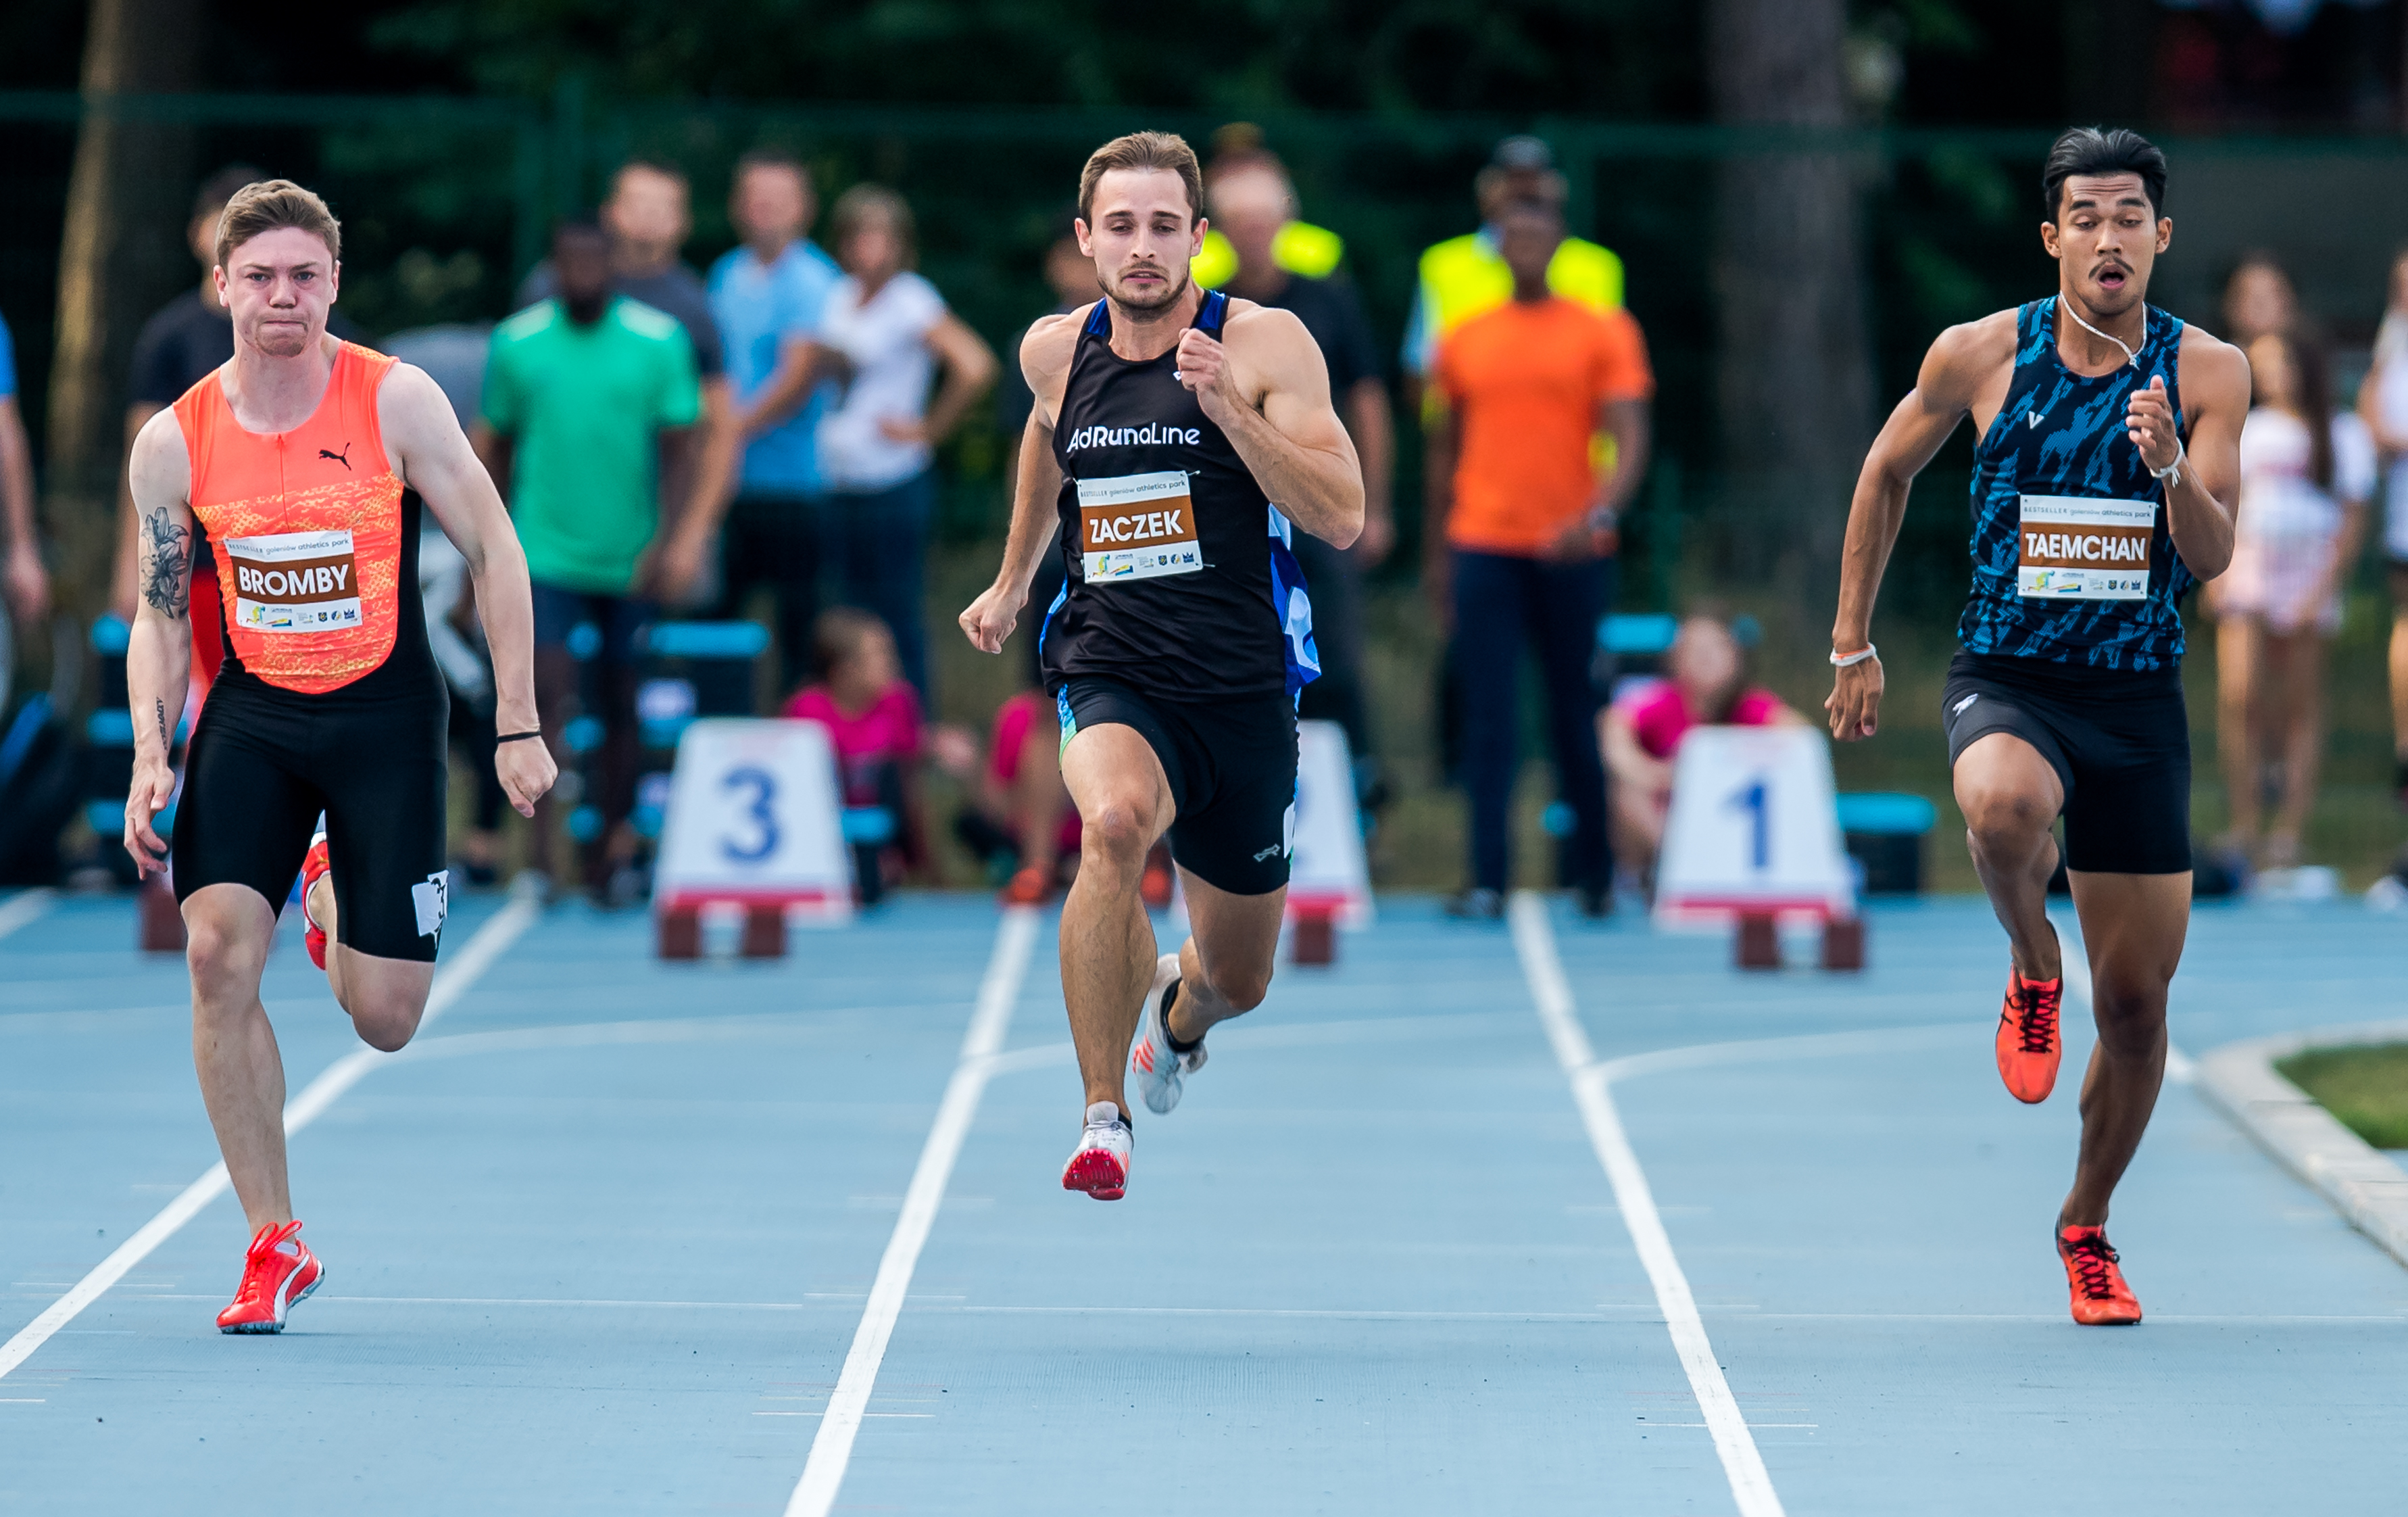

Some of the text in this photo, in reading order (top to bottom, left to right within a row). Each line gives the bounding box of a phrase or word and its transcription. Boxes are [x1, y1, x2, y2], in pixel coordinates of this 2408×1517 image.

[1136, 482, 1167, 493] athletics
[1169, 480, 1186, 489] park
[1089, 509, 1184, 544] ZACZEK
[2102, 509, 2133, 517] athletics
[228, 543, 264, 554] BESTSELLER
[297, 540, 330, 550] athletics
[332, 537, 349, 548] park
[2025, 533, 2146, 561] TAEMCHAN
[239, 563, 349, 596] BROMBY
[718, 761, 781, 865] 3
[1720, 772, 1771, 870] 1
